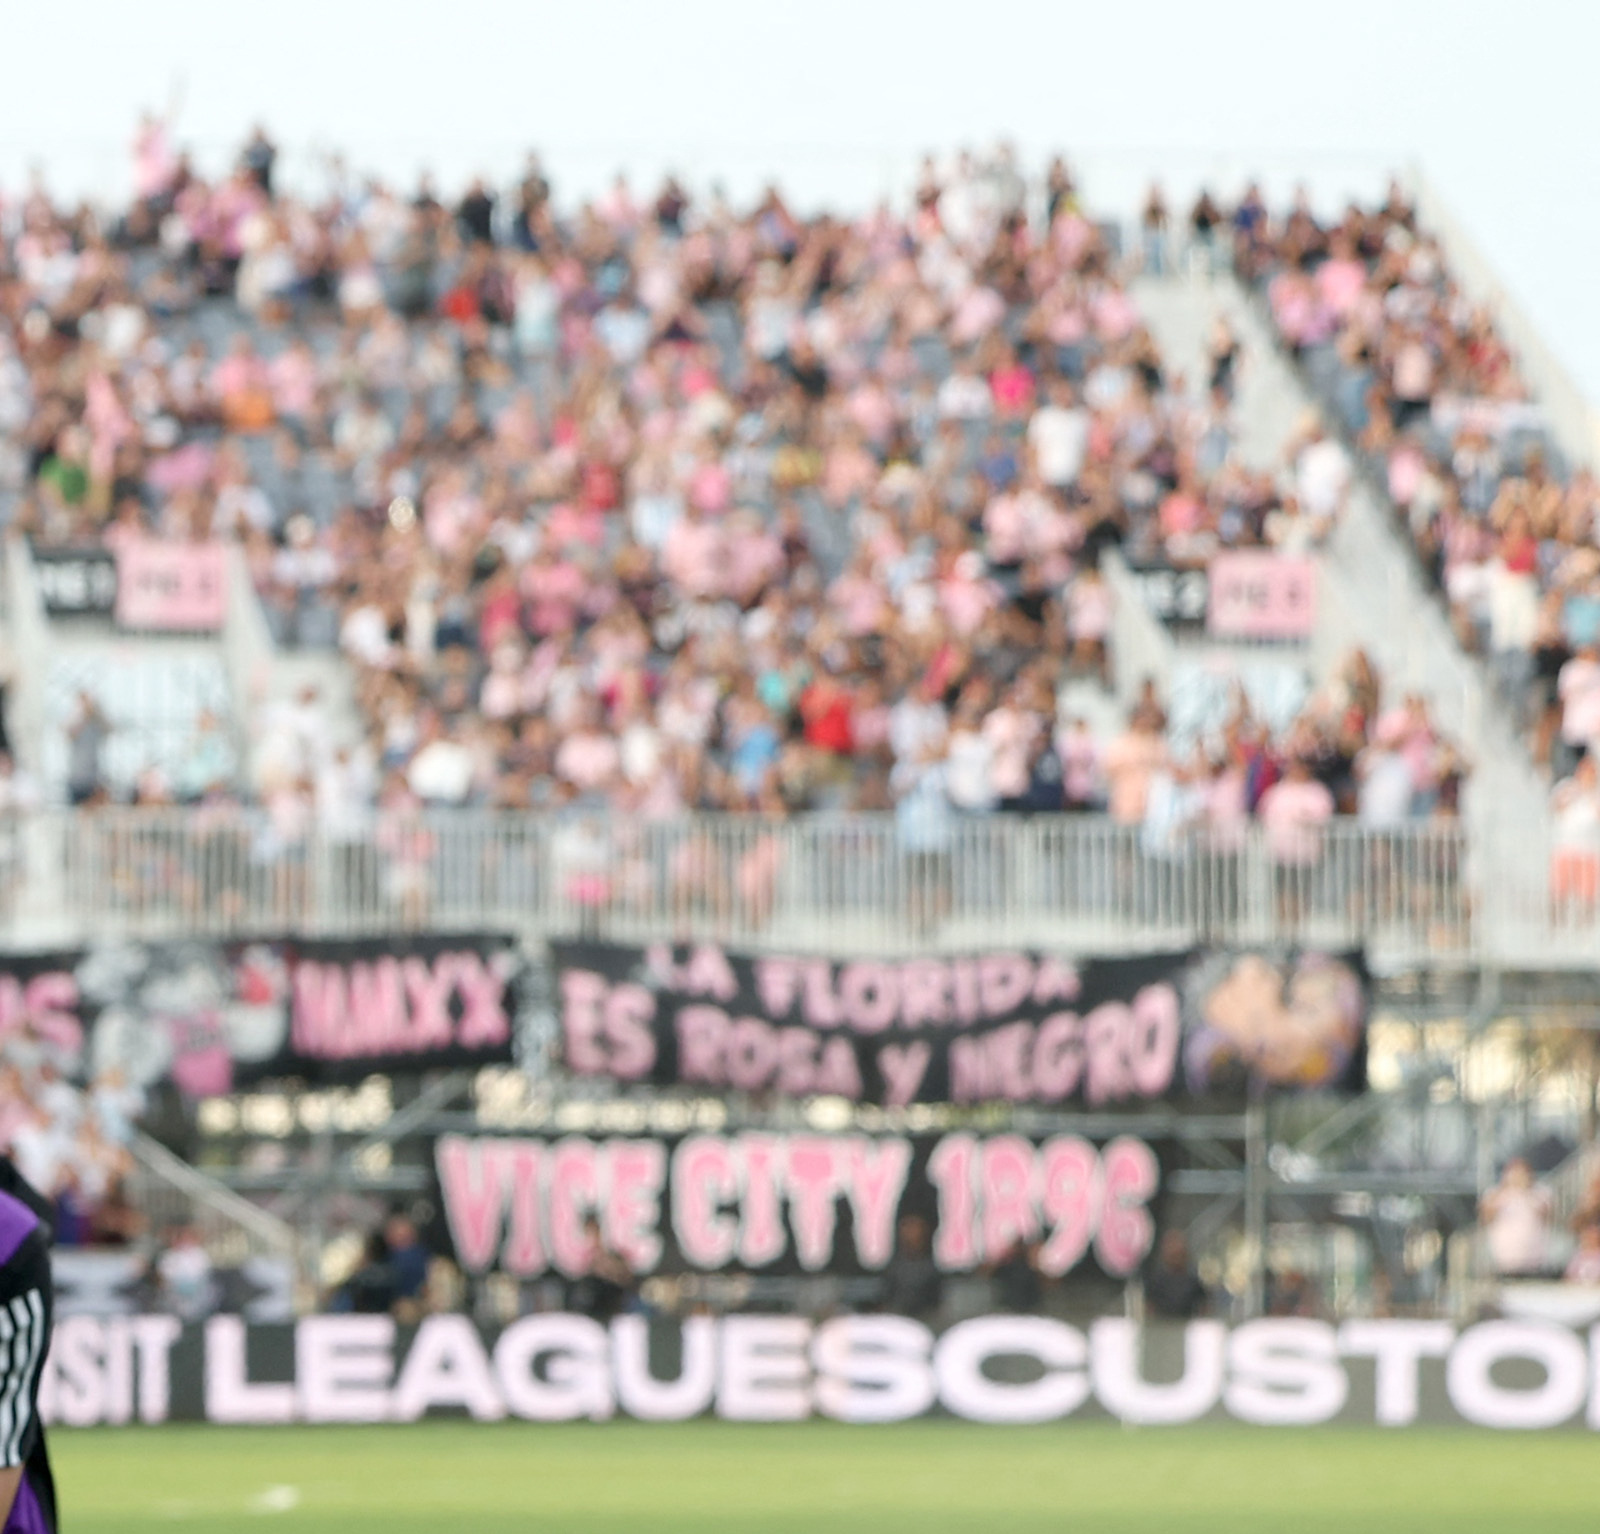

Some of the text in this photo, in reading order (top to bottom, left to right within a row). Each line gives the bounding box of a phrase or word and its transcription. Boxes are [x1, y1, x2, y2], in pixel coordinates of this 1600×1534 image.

[560, 968, 657, 1080] ES
[676, 1004, 863, 1096] ROSA
[947, 983, 1180, 1102] NEGRO
[754, 952, 1082, 1034] FLORIDA
[434, 1131, 1160, 1279] VICE CITY 1896
[204, 1312, 1600, 1430] LEAGUESCUSTO
